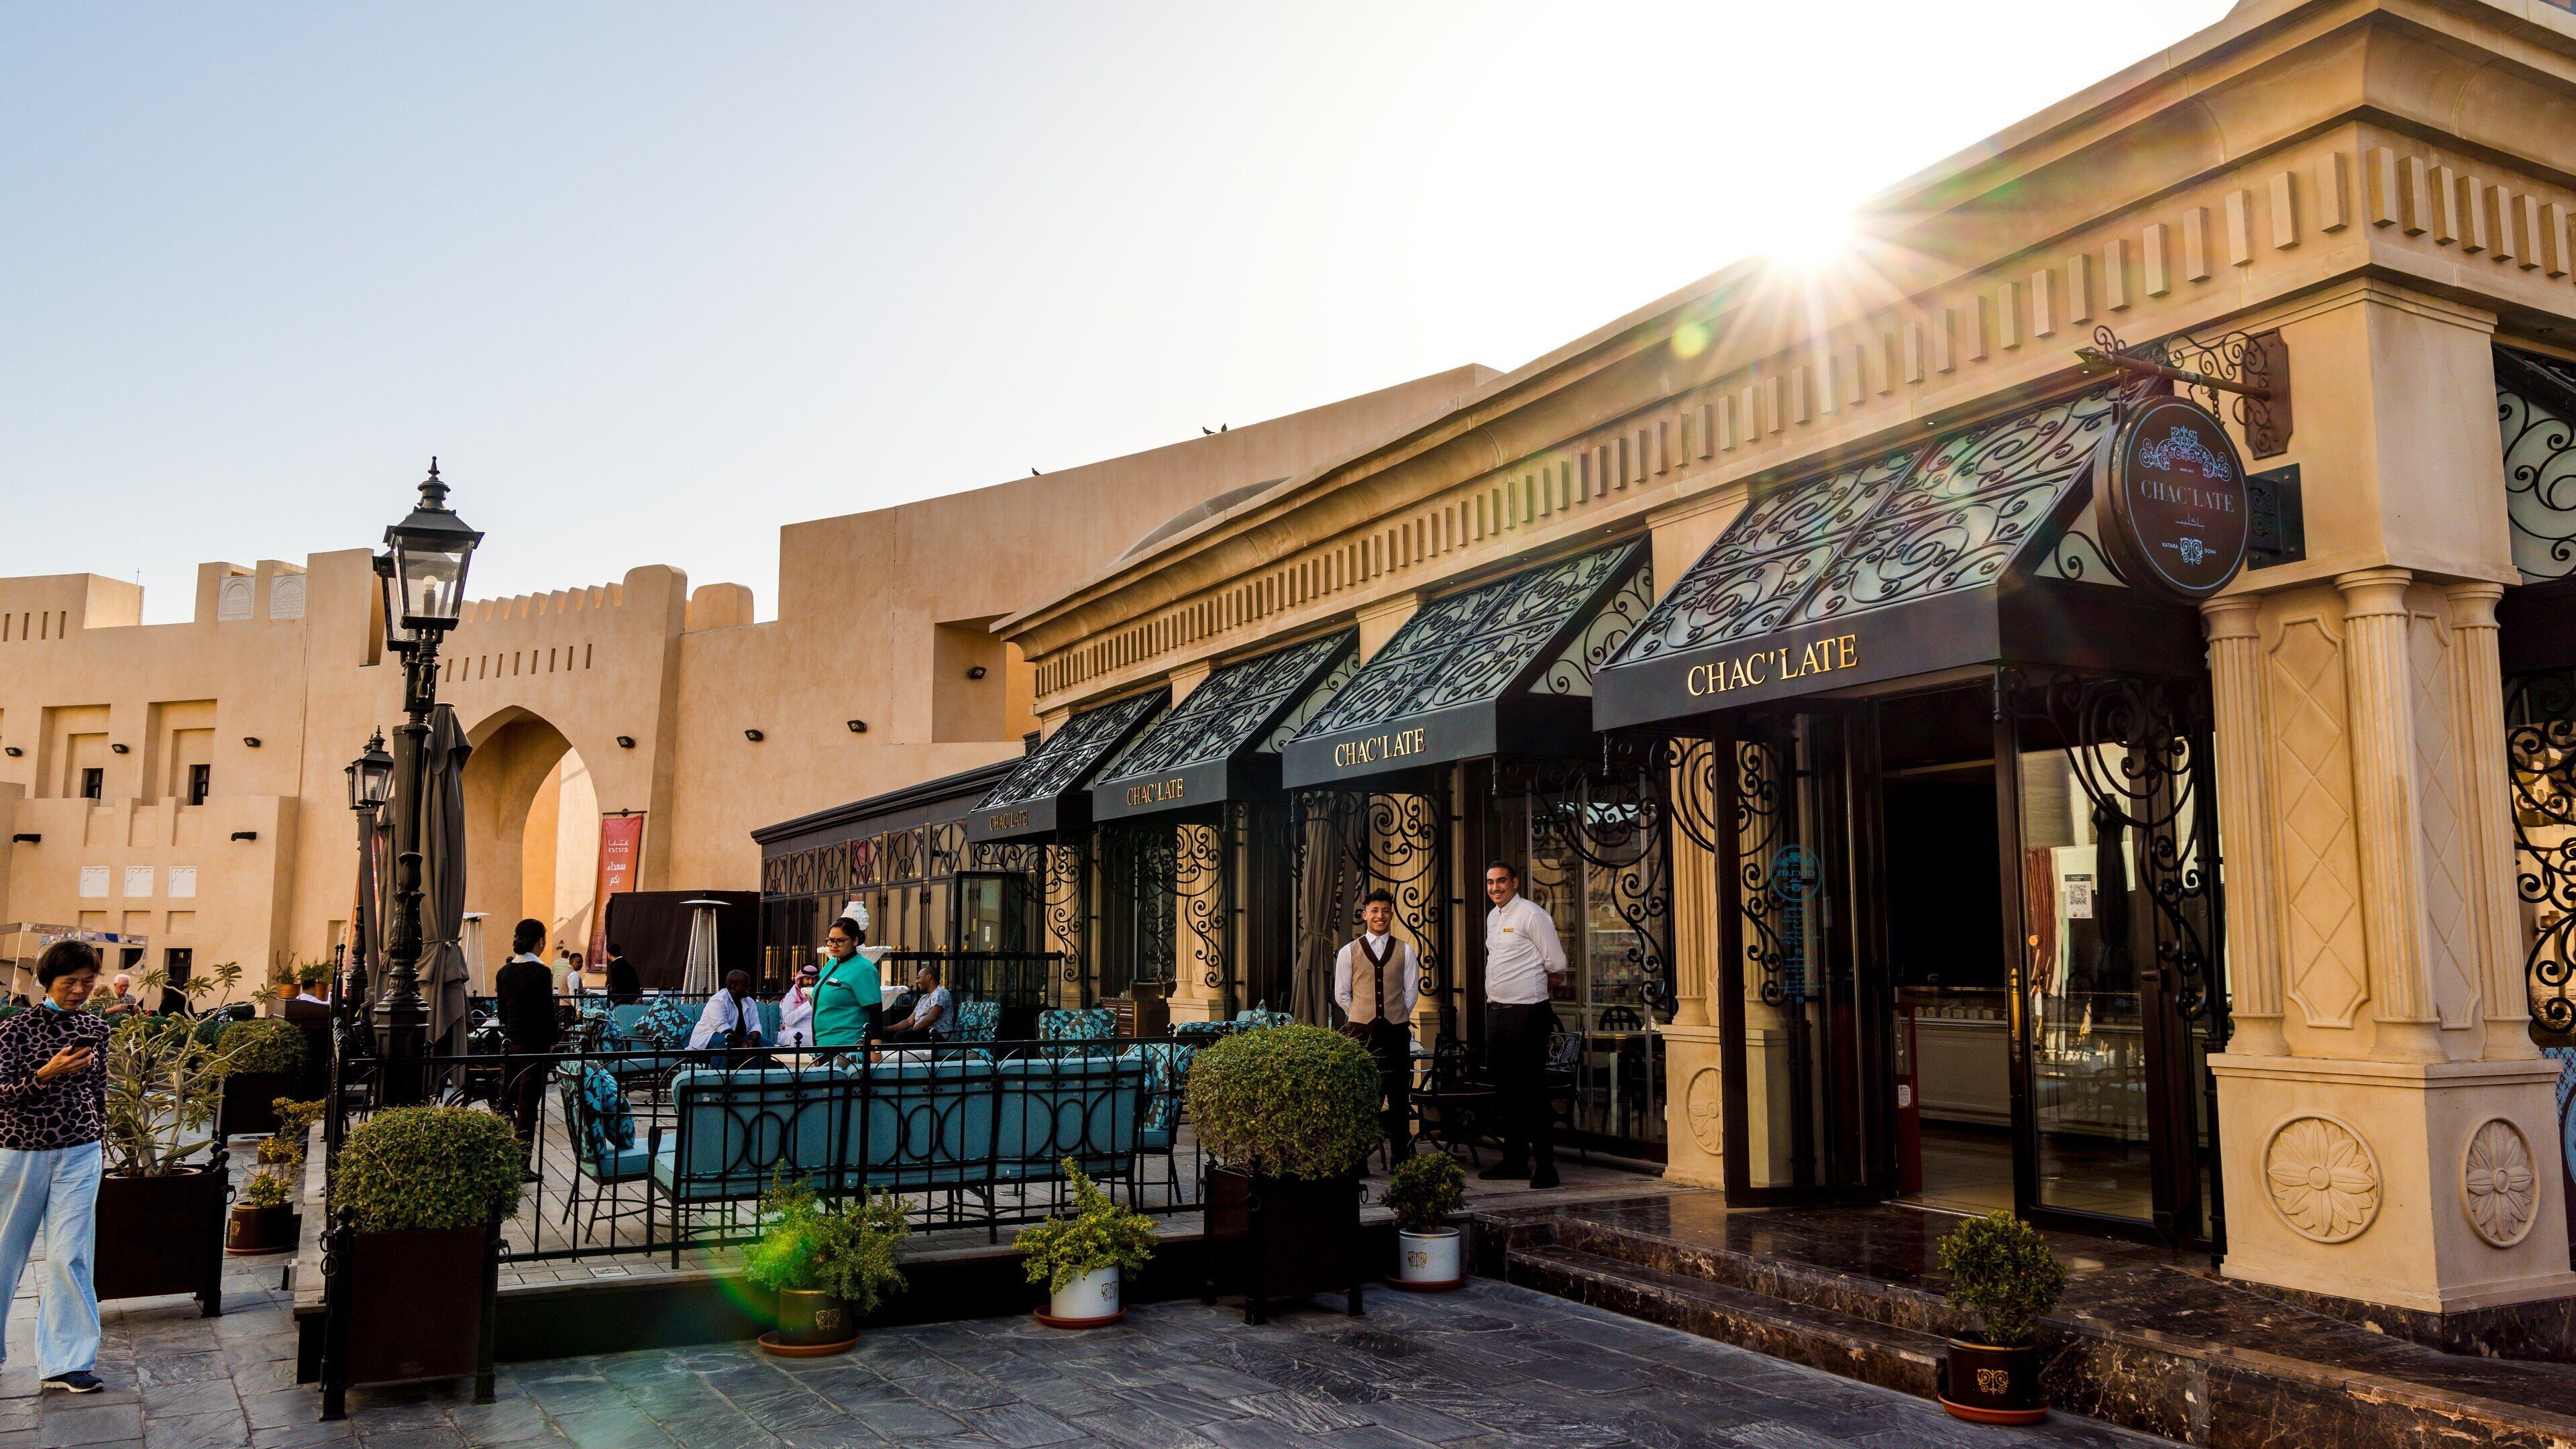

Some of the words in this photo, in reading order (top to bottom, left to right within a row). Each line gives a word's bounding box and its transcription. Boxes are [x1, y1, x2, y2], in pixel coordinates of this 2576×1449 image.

[2141, 480, 2234, 512] CHAC'LATE
[1687, 634, 1858, 696] CHAC'LATE
[1335, 728, 1426, 767] CHAC'LATE
[1126, 778, 1184, 806] CHAC'LATE
[989, 810, 1028, 831] CHAC'LATE
[607, 861, 626, 871] سعداء
[609, 874, 620, 886] بكم
